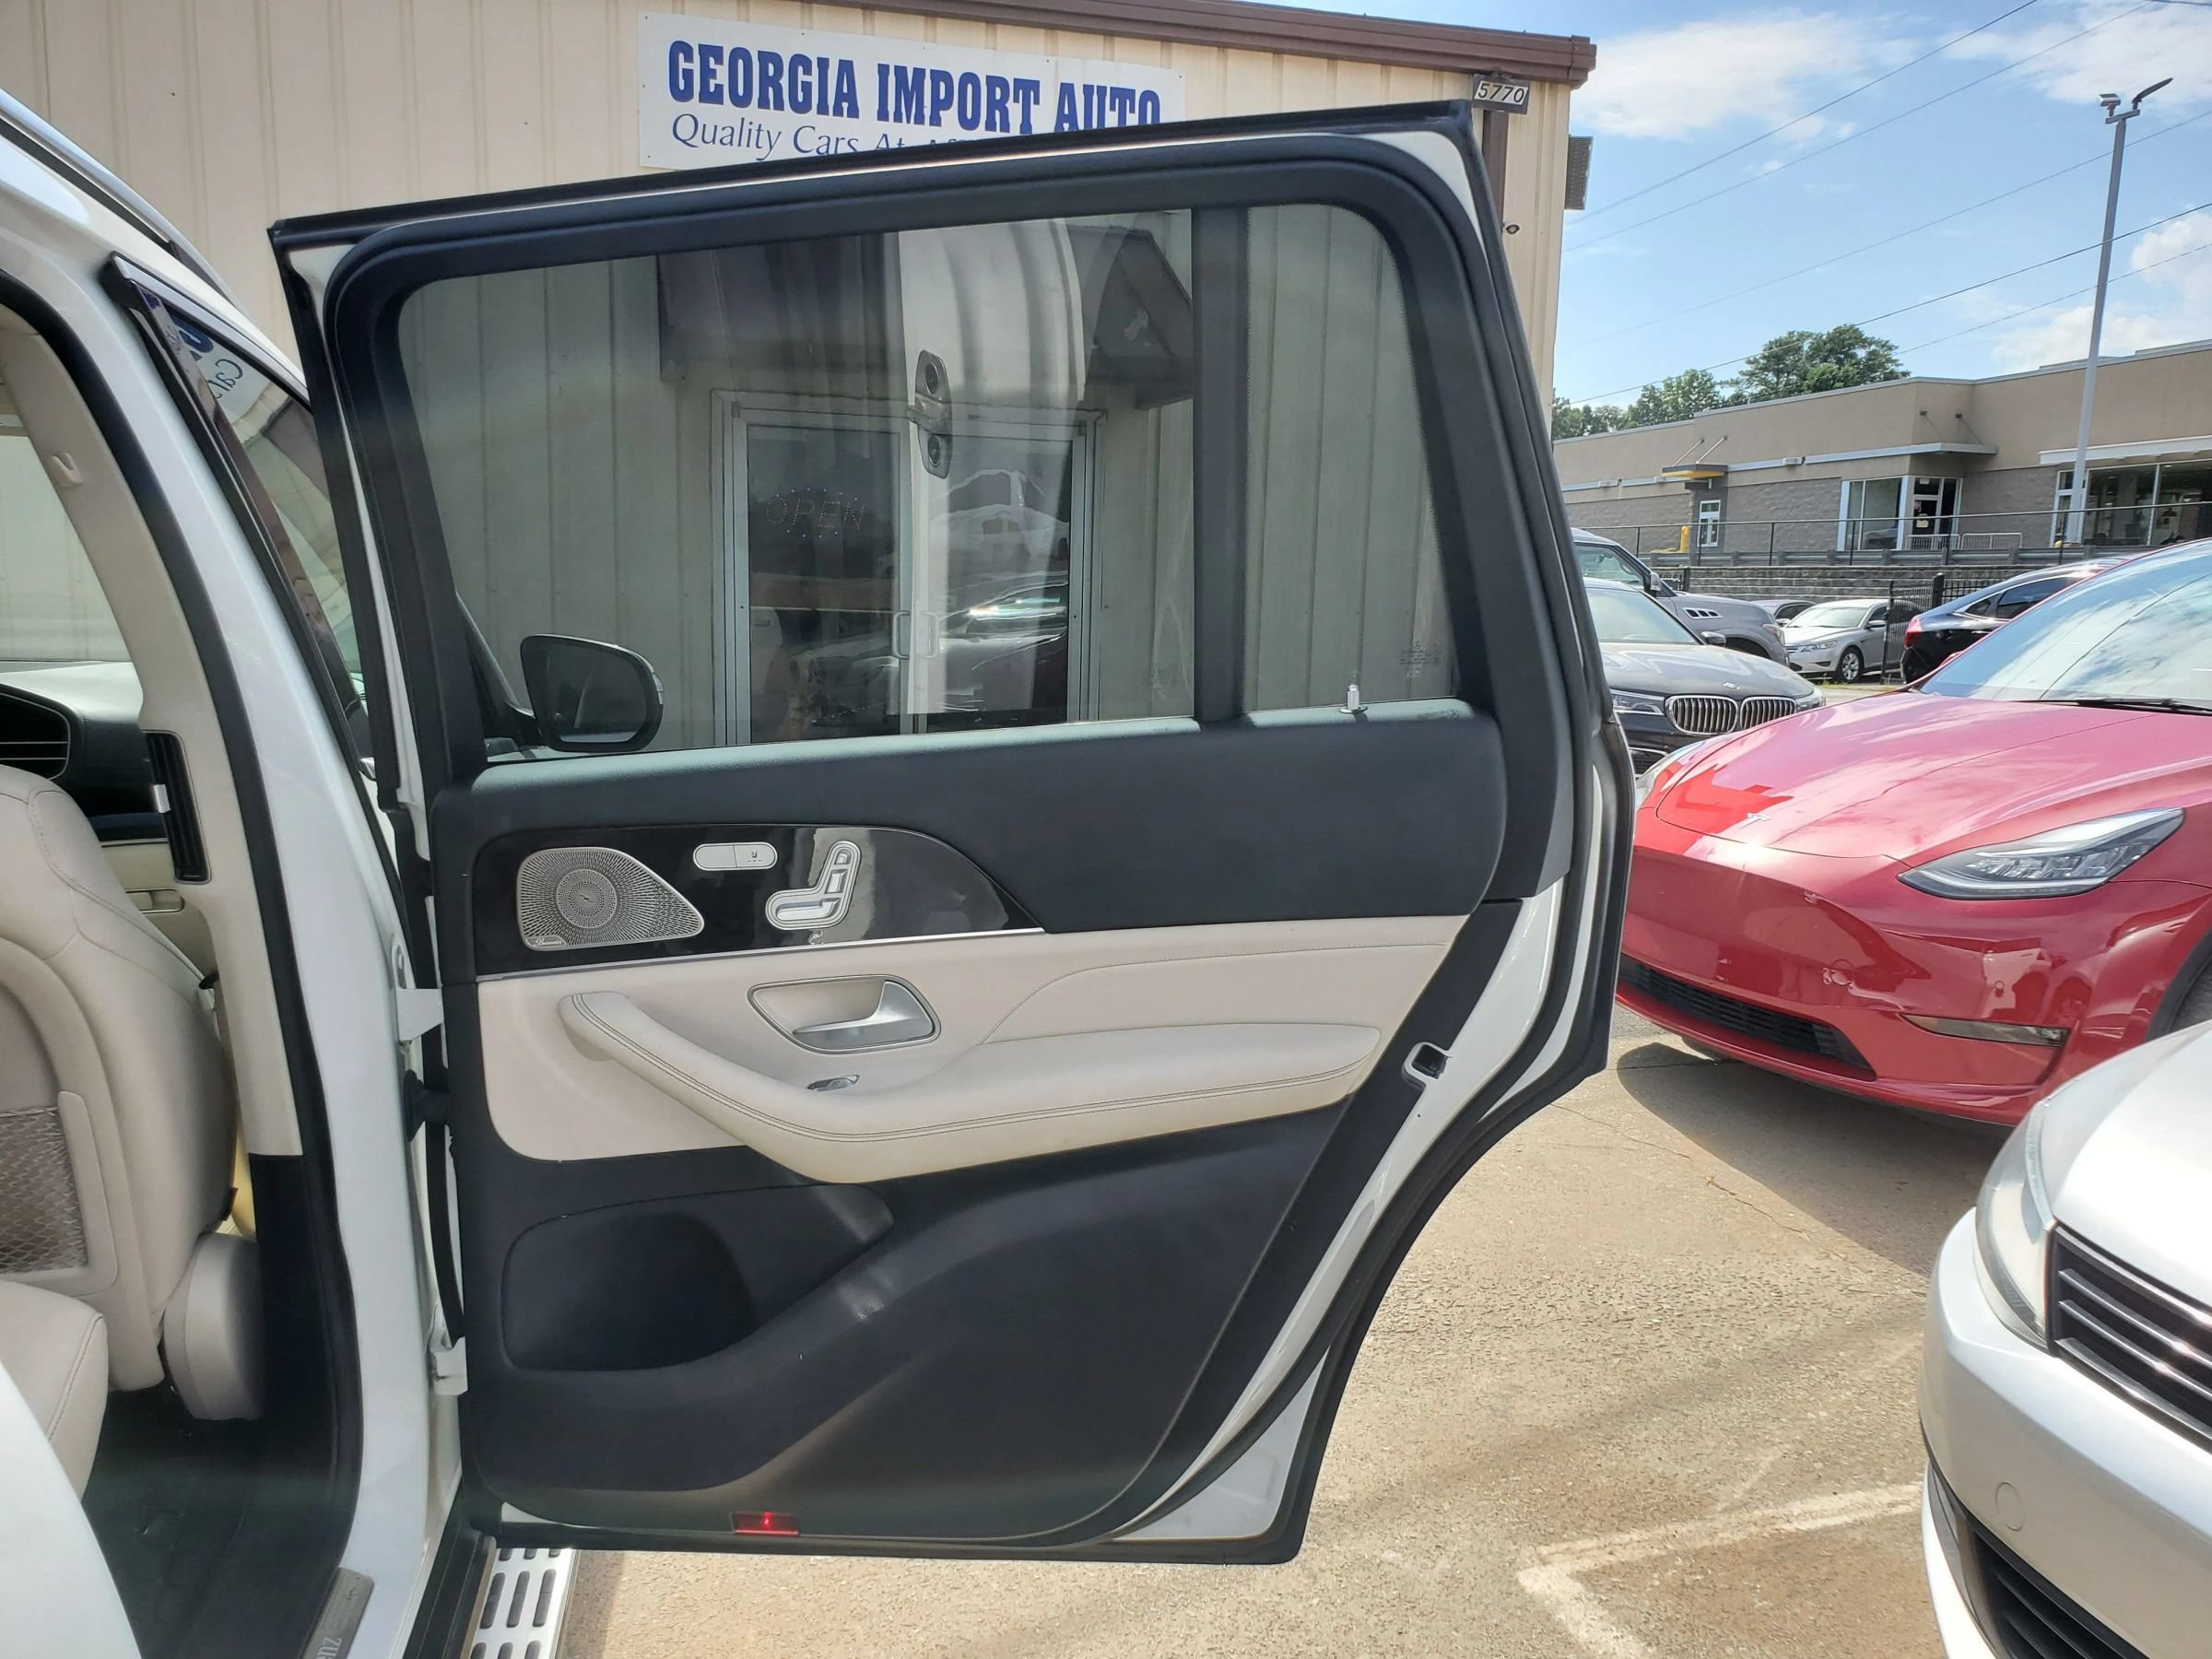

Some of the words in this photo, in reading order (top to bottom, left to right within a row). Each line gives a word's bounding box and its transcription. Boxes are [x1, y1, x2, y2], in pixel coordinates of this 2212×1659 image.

[668, 40, 860, 120] GEORGIA
[877, 63, 1041, 135] IMPORT
[1053, 82, 1161, 133] AUTO
[1477, 83, 1524, 103] 5770
[672, 113, 782, 161] Quality
[793, 125, 860, 155] Cars
[766, 497, 865, 531] OPEN
